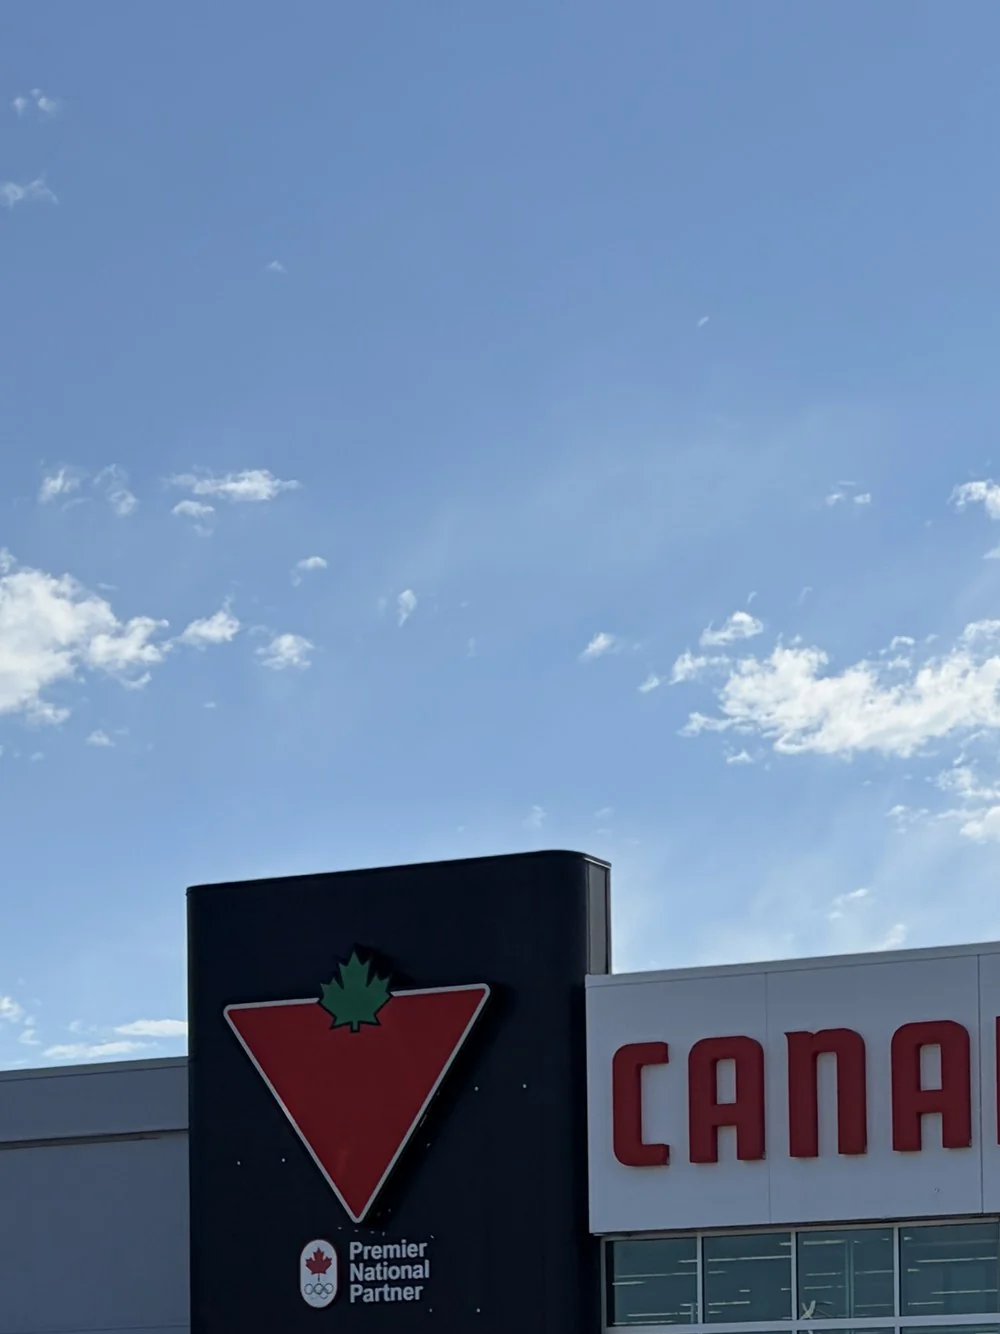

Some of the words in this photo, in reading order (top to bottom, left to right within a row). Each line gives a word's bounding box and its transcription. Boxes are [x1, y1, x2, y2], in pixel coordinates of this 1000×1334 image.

[349, 1239, 428, 1261] Premier
[349, 1259, 430, 1282] National
[349, 1283, 424, 1303] Partner
